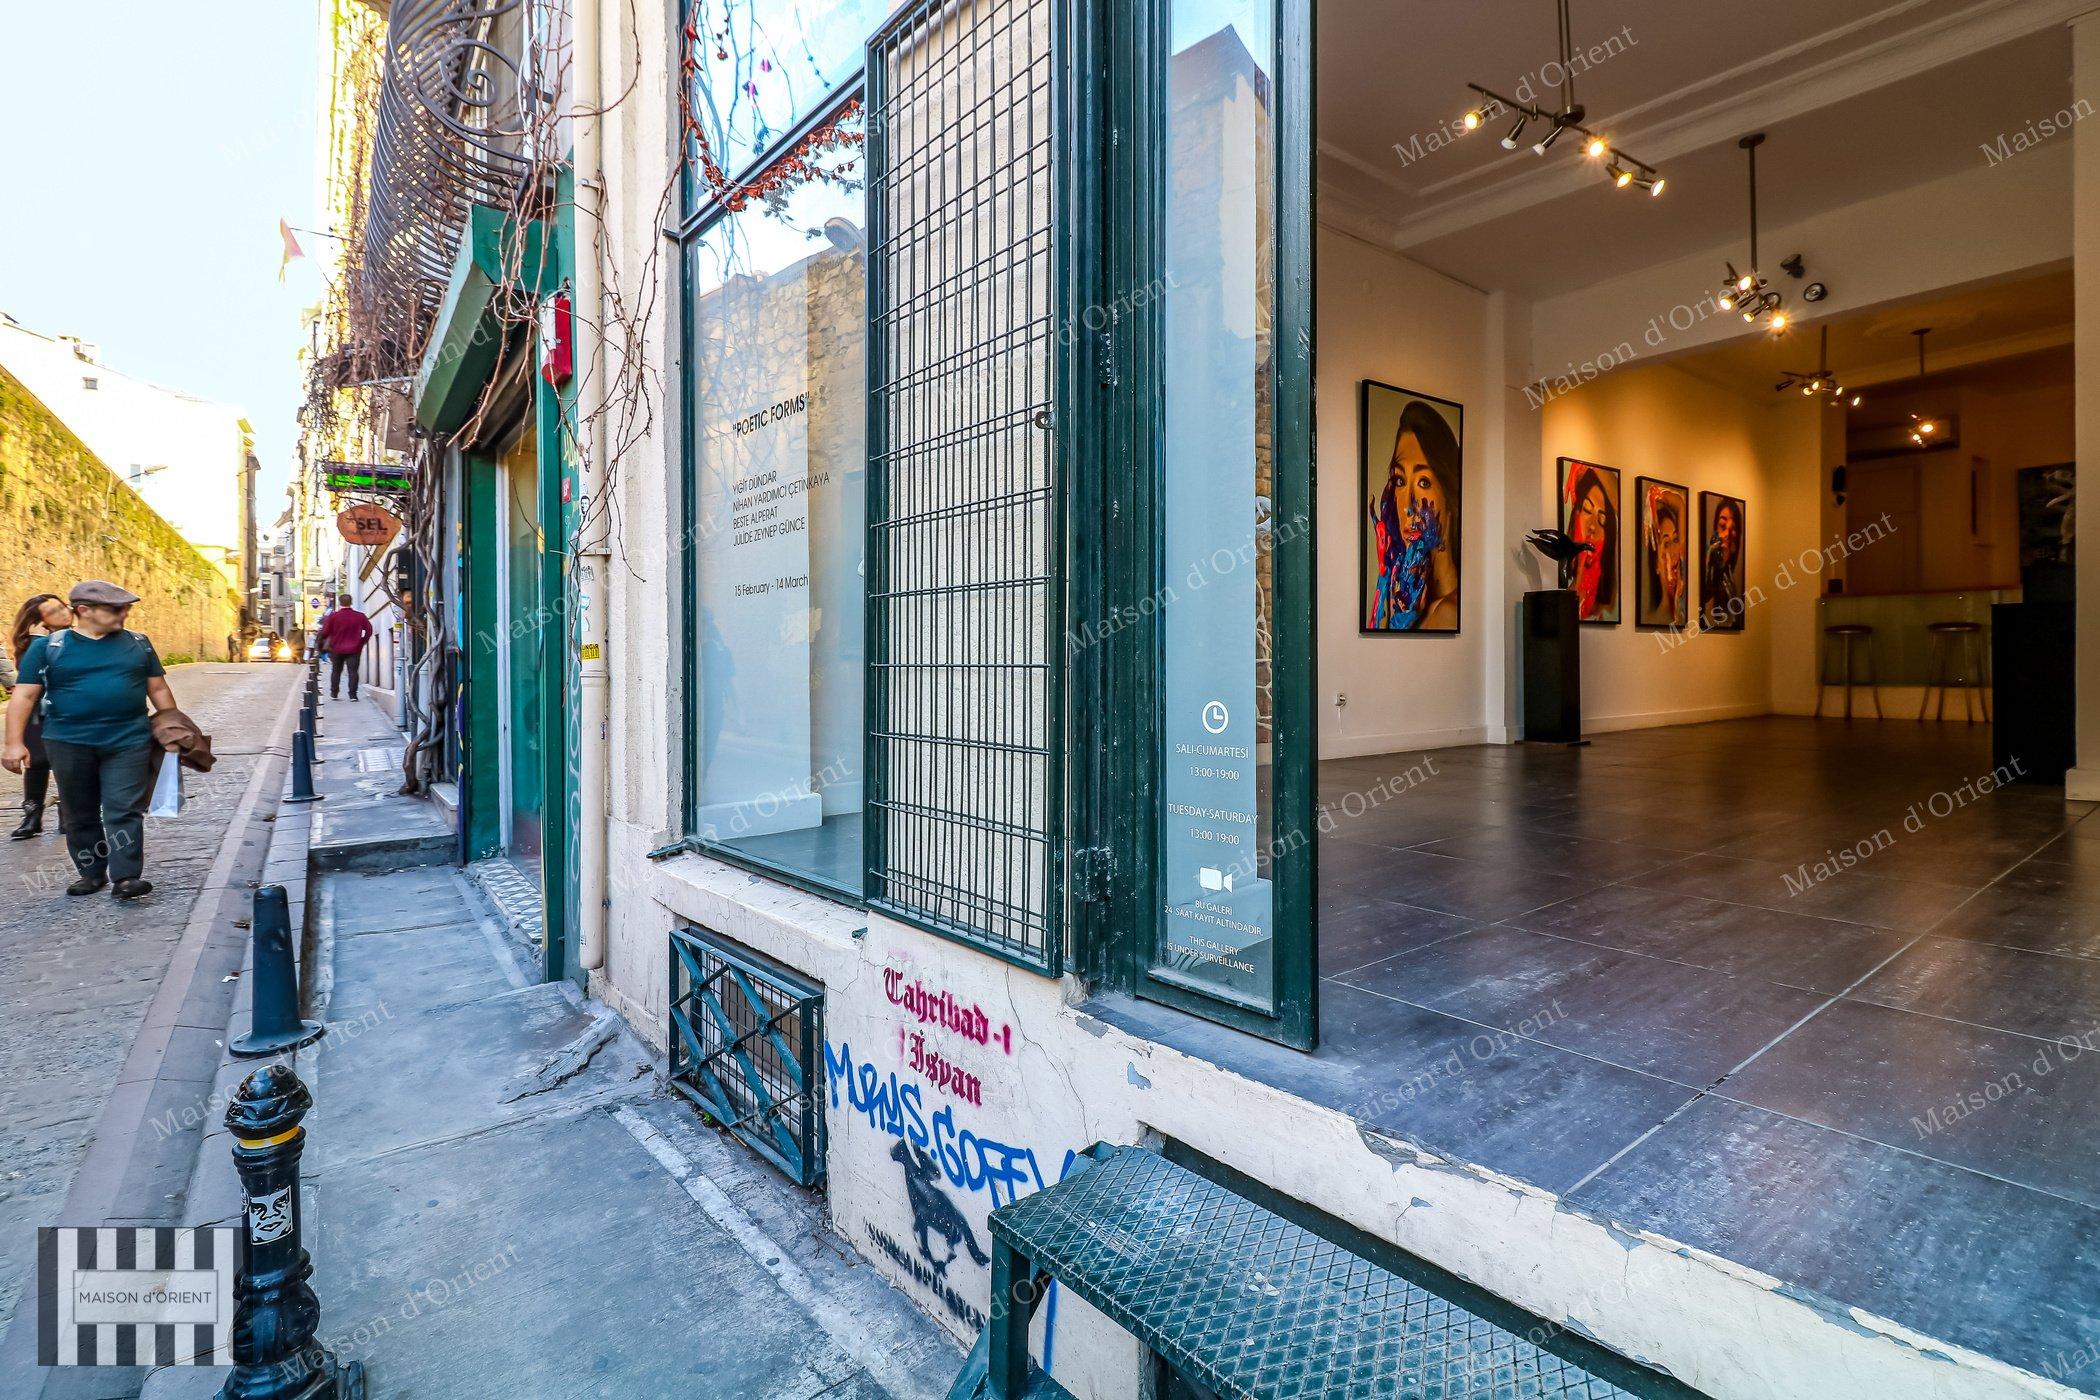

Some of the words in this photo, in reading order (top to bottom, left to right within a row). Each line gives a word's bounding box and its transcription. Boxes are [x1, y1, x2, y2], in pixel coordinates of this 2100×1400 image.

[748, 470, 777, 491] DÜNDAR
[754, 485, 787, 505] YARDIMCI
[733, 515, 749, 529] BESTE
[750, 506, 778, 525] ALPERAT
[754, 524, 777, 541] ZEYNEP
[778, 516, 805, 534] GÜNCE
[734, 585, 742, 596] 15
[742, 582, 770, 595] February
[776, 578, 784, 590] 14
[784, 574, 809, 589] March
[1190, 766, 1239, 780] 13:00-19:00
[1168, 803, 1258, 825] TUESDAY-SATURDAY
[1190, 828, 1213, 841] 13:00
[1216, 832, 1239, 845] 19:00
[1195, 899, 1205, 910] BU
[1164, 905, 1173, 914] 24
[1175, 907, 1194, 919] SAAT
[1194, 912, 1215, 924] KAYIT
[1215, 918, 1264, 936] ALTINDADIR.
[1189, 935, 1205, 947] THIS
[1206, 941, 1240, 956] GALLERY
[1167, 942, 1173, 951] IS
[1174, 944, 1199, 958] UNDER
[1199, 951, 1255, 974] SURVEILLANCE
